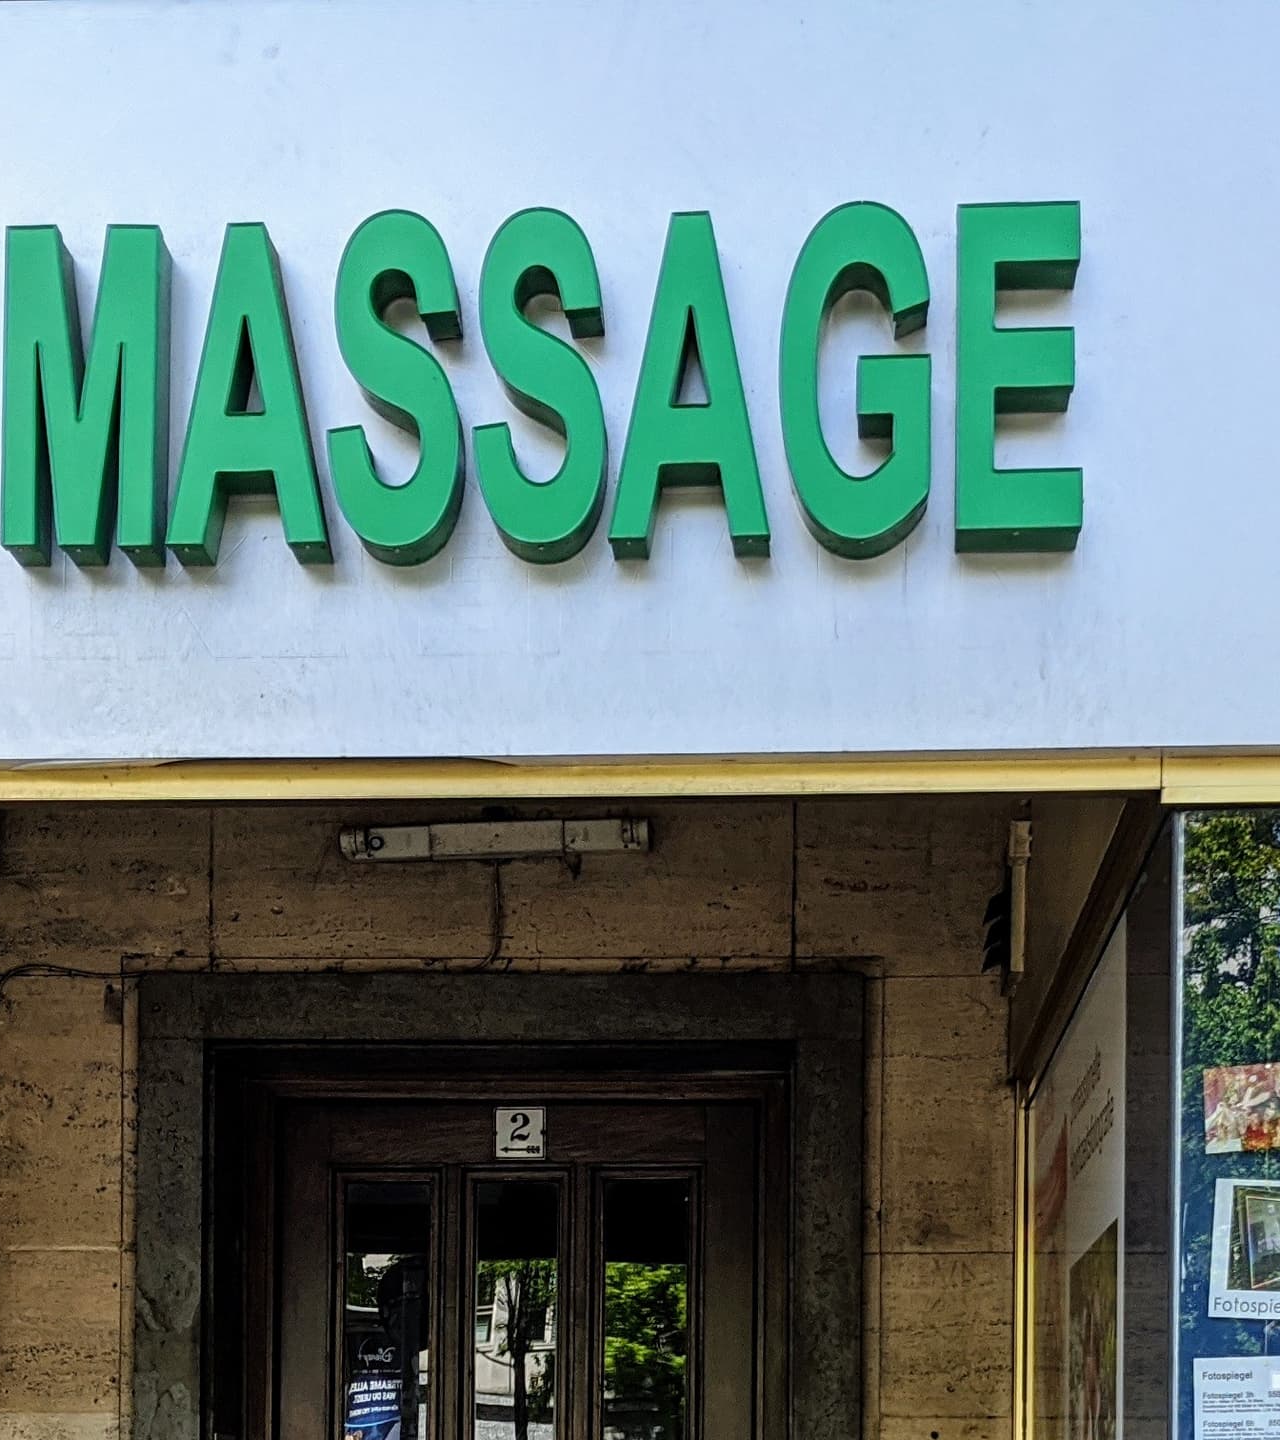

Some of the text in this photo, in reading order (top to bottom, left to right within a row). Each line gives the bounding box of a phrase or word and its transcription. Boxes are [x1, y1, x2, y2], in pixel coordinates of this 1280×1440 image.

[0, 201, 1084, 569] MASSAGE
[510, 1113, 530, 1142] 2
[1202, 1371, 1253, 1382] Fotospiegel
